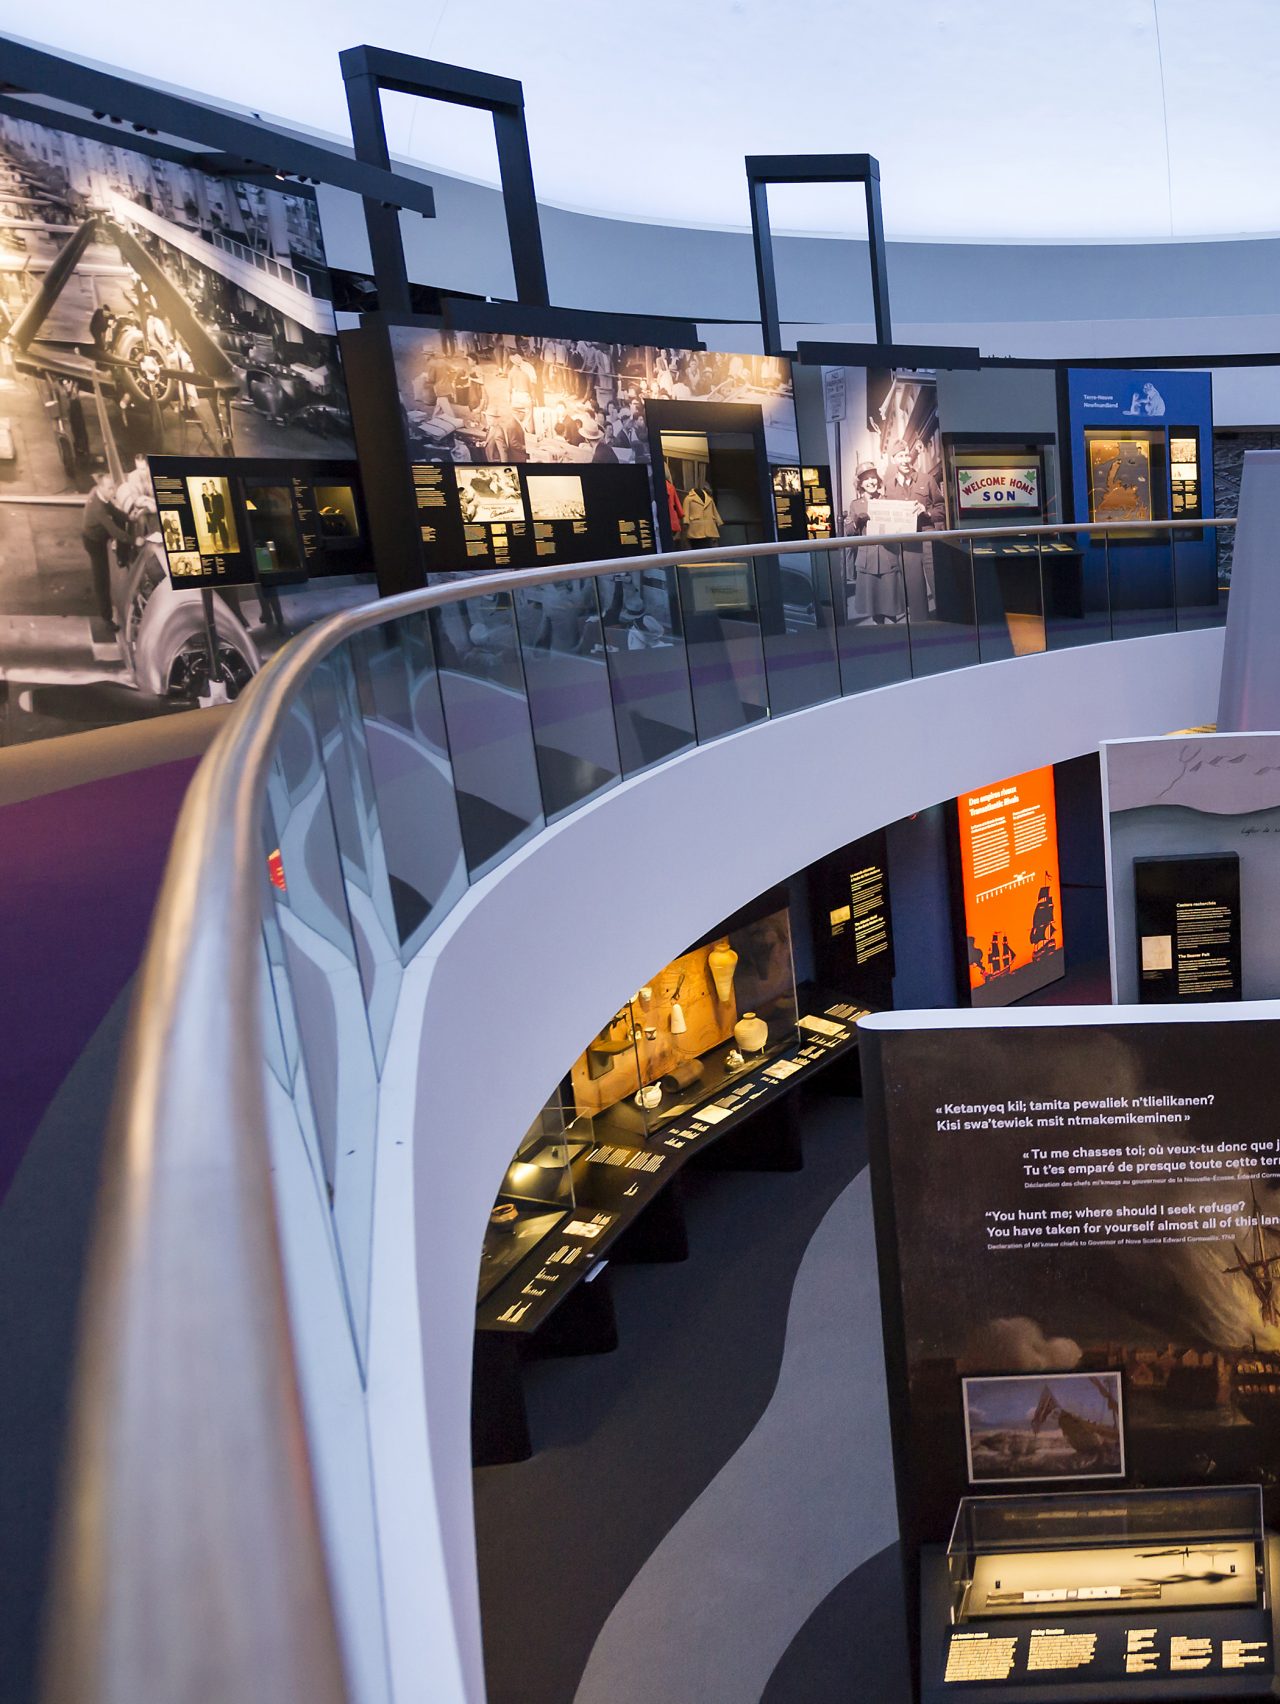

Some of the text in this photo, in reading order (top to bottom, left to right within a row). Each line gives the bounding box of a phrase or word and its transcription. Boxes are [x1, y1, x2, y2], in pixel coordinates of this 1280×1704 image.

[962, 476, 1036, 496] WELCOME HOME
[982, 491, 1015, 501] SON
[1008, 1099, 1028, 1113] kil;
[1030, 1098, 1070, 1112] tamita
[1073, 1096, 1128, 1112] pewaliek
[937, 1119, 960, 1131] Kisi
[1036, 1116, 1064, 1127] msit
[1051, 1150, 1070, 1159] me
[1072, 1147, 1122, 1158] chasses
[1126, 1145, 1145, 1157] toi;
[1148, 1144, 1164, 1155] où
[1167, 1143, 1214, 1154] veux-tu
[1217, 1142, 1247, 1152] donc
[1250, 1142, 1274, 1153] que
[1024, 1165, 1040, 1176] Tu
[1068, 1162, 1114, 1175] emparé
[1118, 1162, 1133, 1172] de
[1136, 1161, 1186, 1173] presque
[1189, 1159, 1222, 1170] toute
[1225, 1158, 1258, 1168] cette
[1132, 1178, 1166, 1186] gouverneur
[1018, 1209, 1047, 1220] hunt
[1050, 1210, 1072, 1220] me;
[1076, 1207, 1113, 1218] where
[1116, 1205, 1157, 1216] should
[1161, 1205, 1164, 1214] I
[1167, 1203, 1195, 1214] seek
[1199, 1201, 1246, 1214] refuge?
[987, 1227, 1010, 1237] You
[1013, 1226, 1042, 1236] have
[1046, 1224, 1080, 1235] taken
[1083, 1222, 1101, 1233] for
[1104, 1220, 1155, 1235] yourself
[1158, 1220, 1199, 1231] almost
[1202, 1218, 1216, 1229] all
[1220, 1217, 1232, 1228] of
[1235, 1216, 1258, 1226] this
